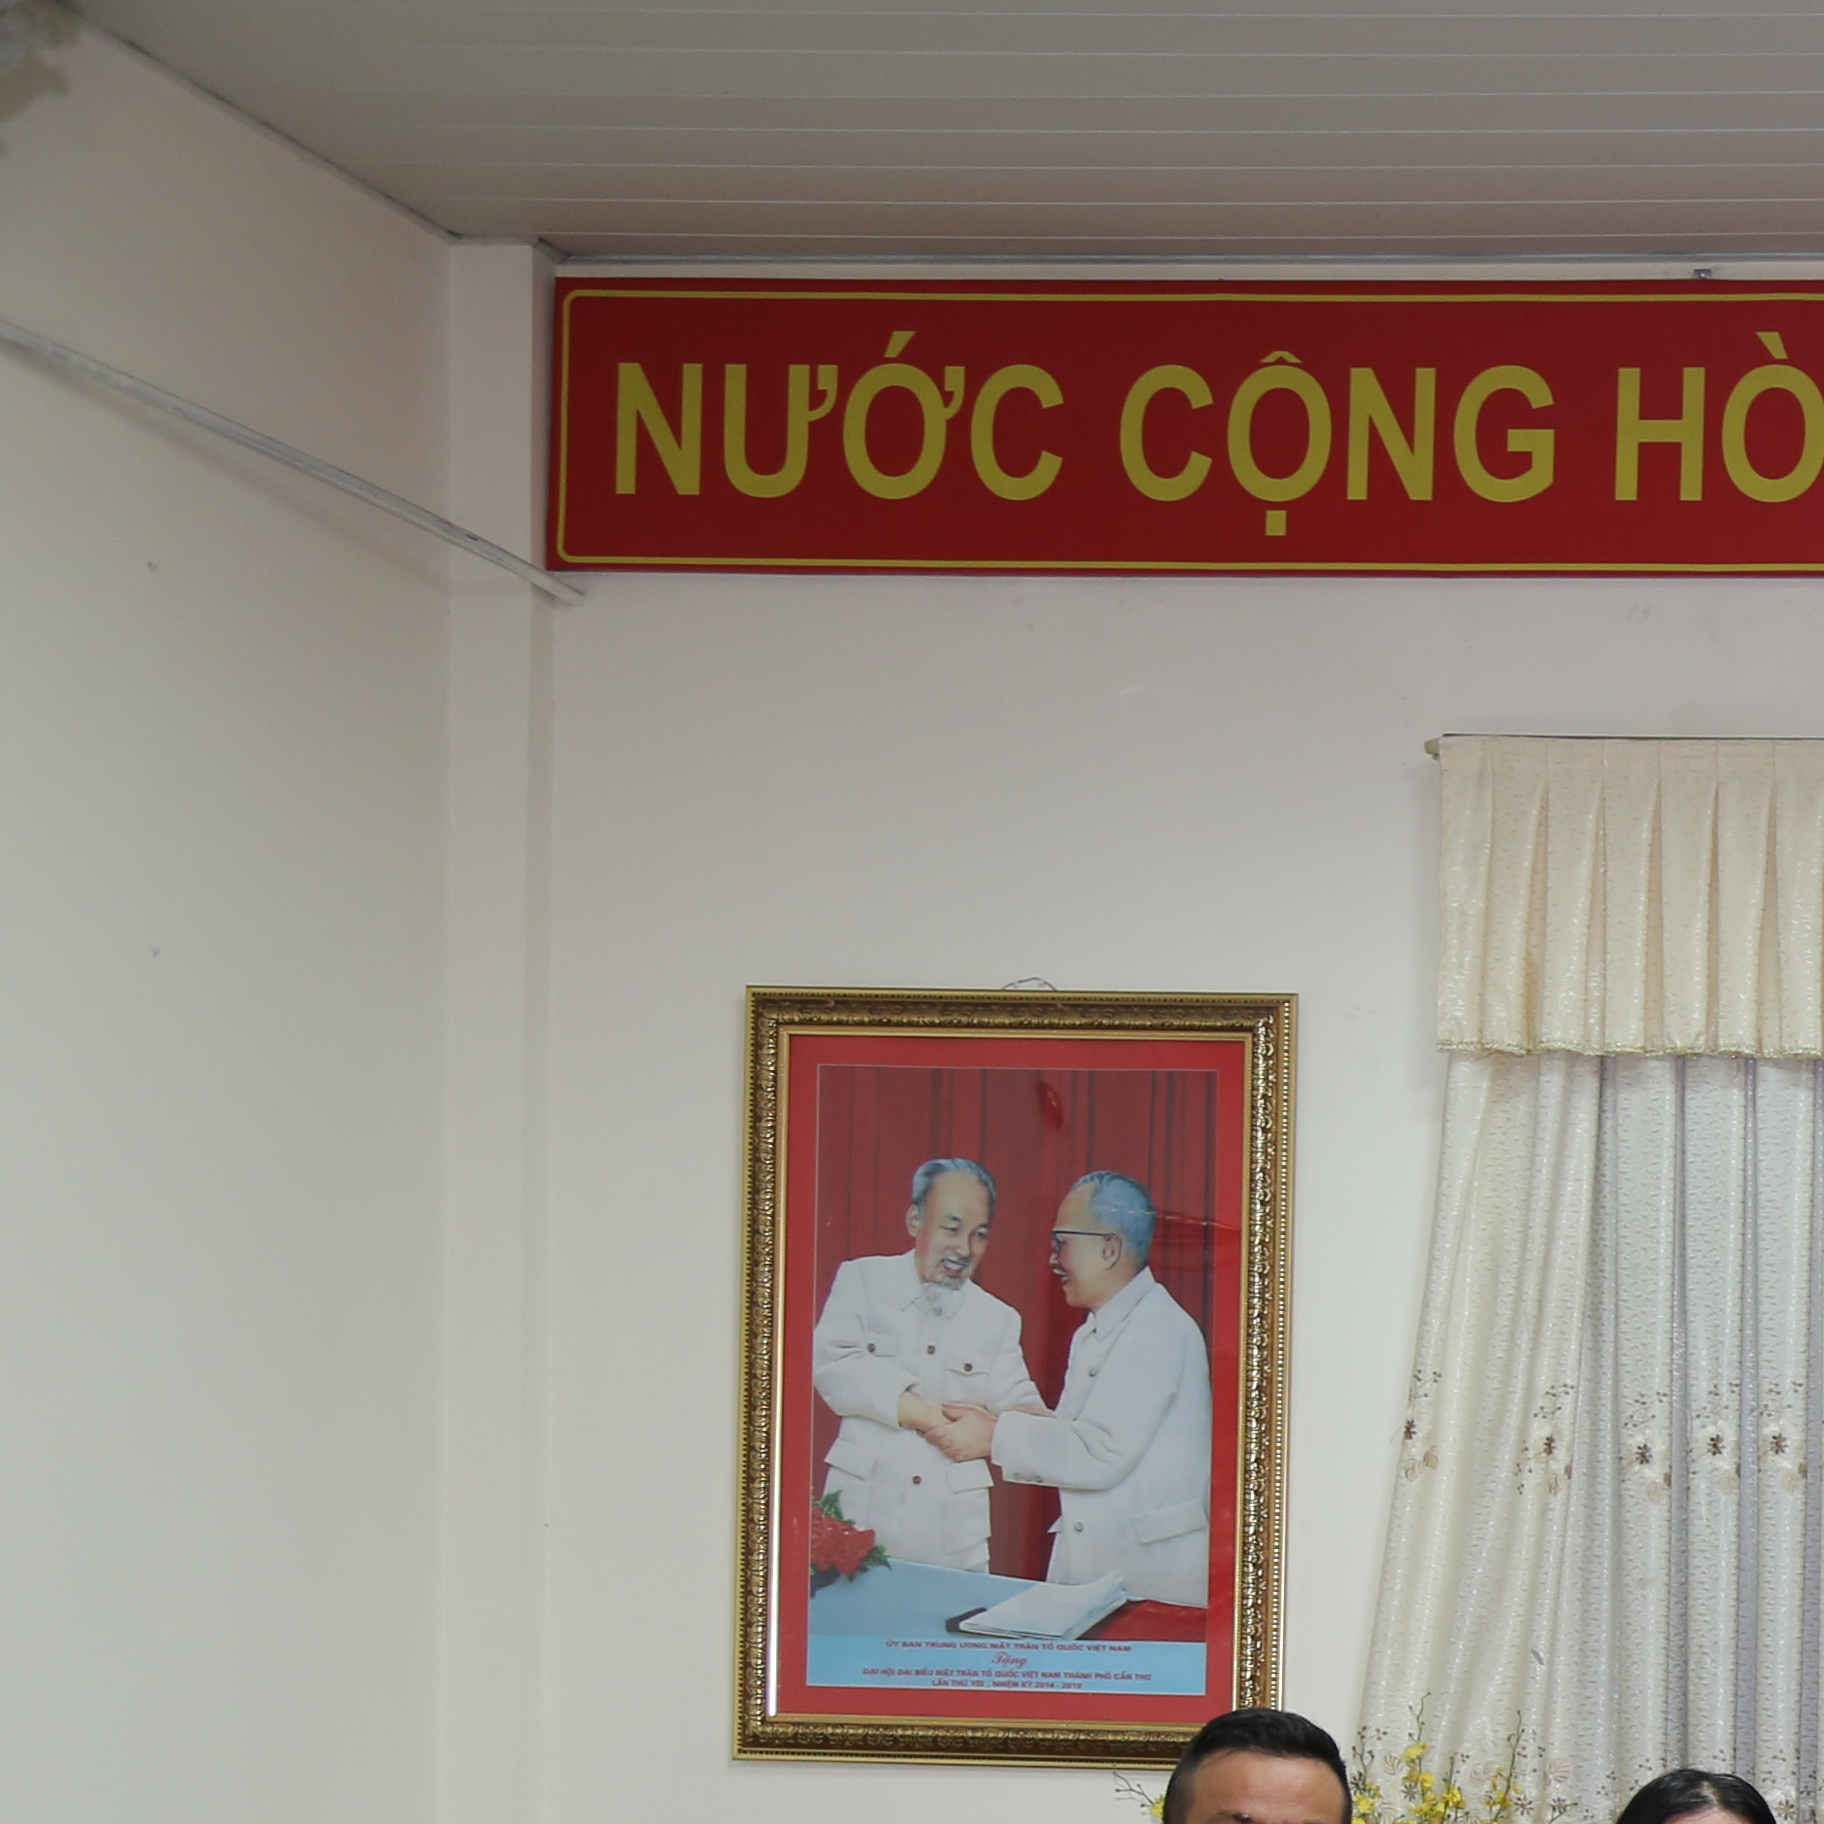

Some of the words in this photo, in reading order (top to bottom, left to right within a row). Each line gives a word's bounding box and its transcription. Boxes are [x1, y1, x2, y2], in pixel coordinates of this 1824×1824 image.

[616, 332, 1065, 502] NƯỚC
[1120, 351, 1557, 536] CỘNG
[902, 1640, 922, 1648] BAN
